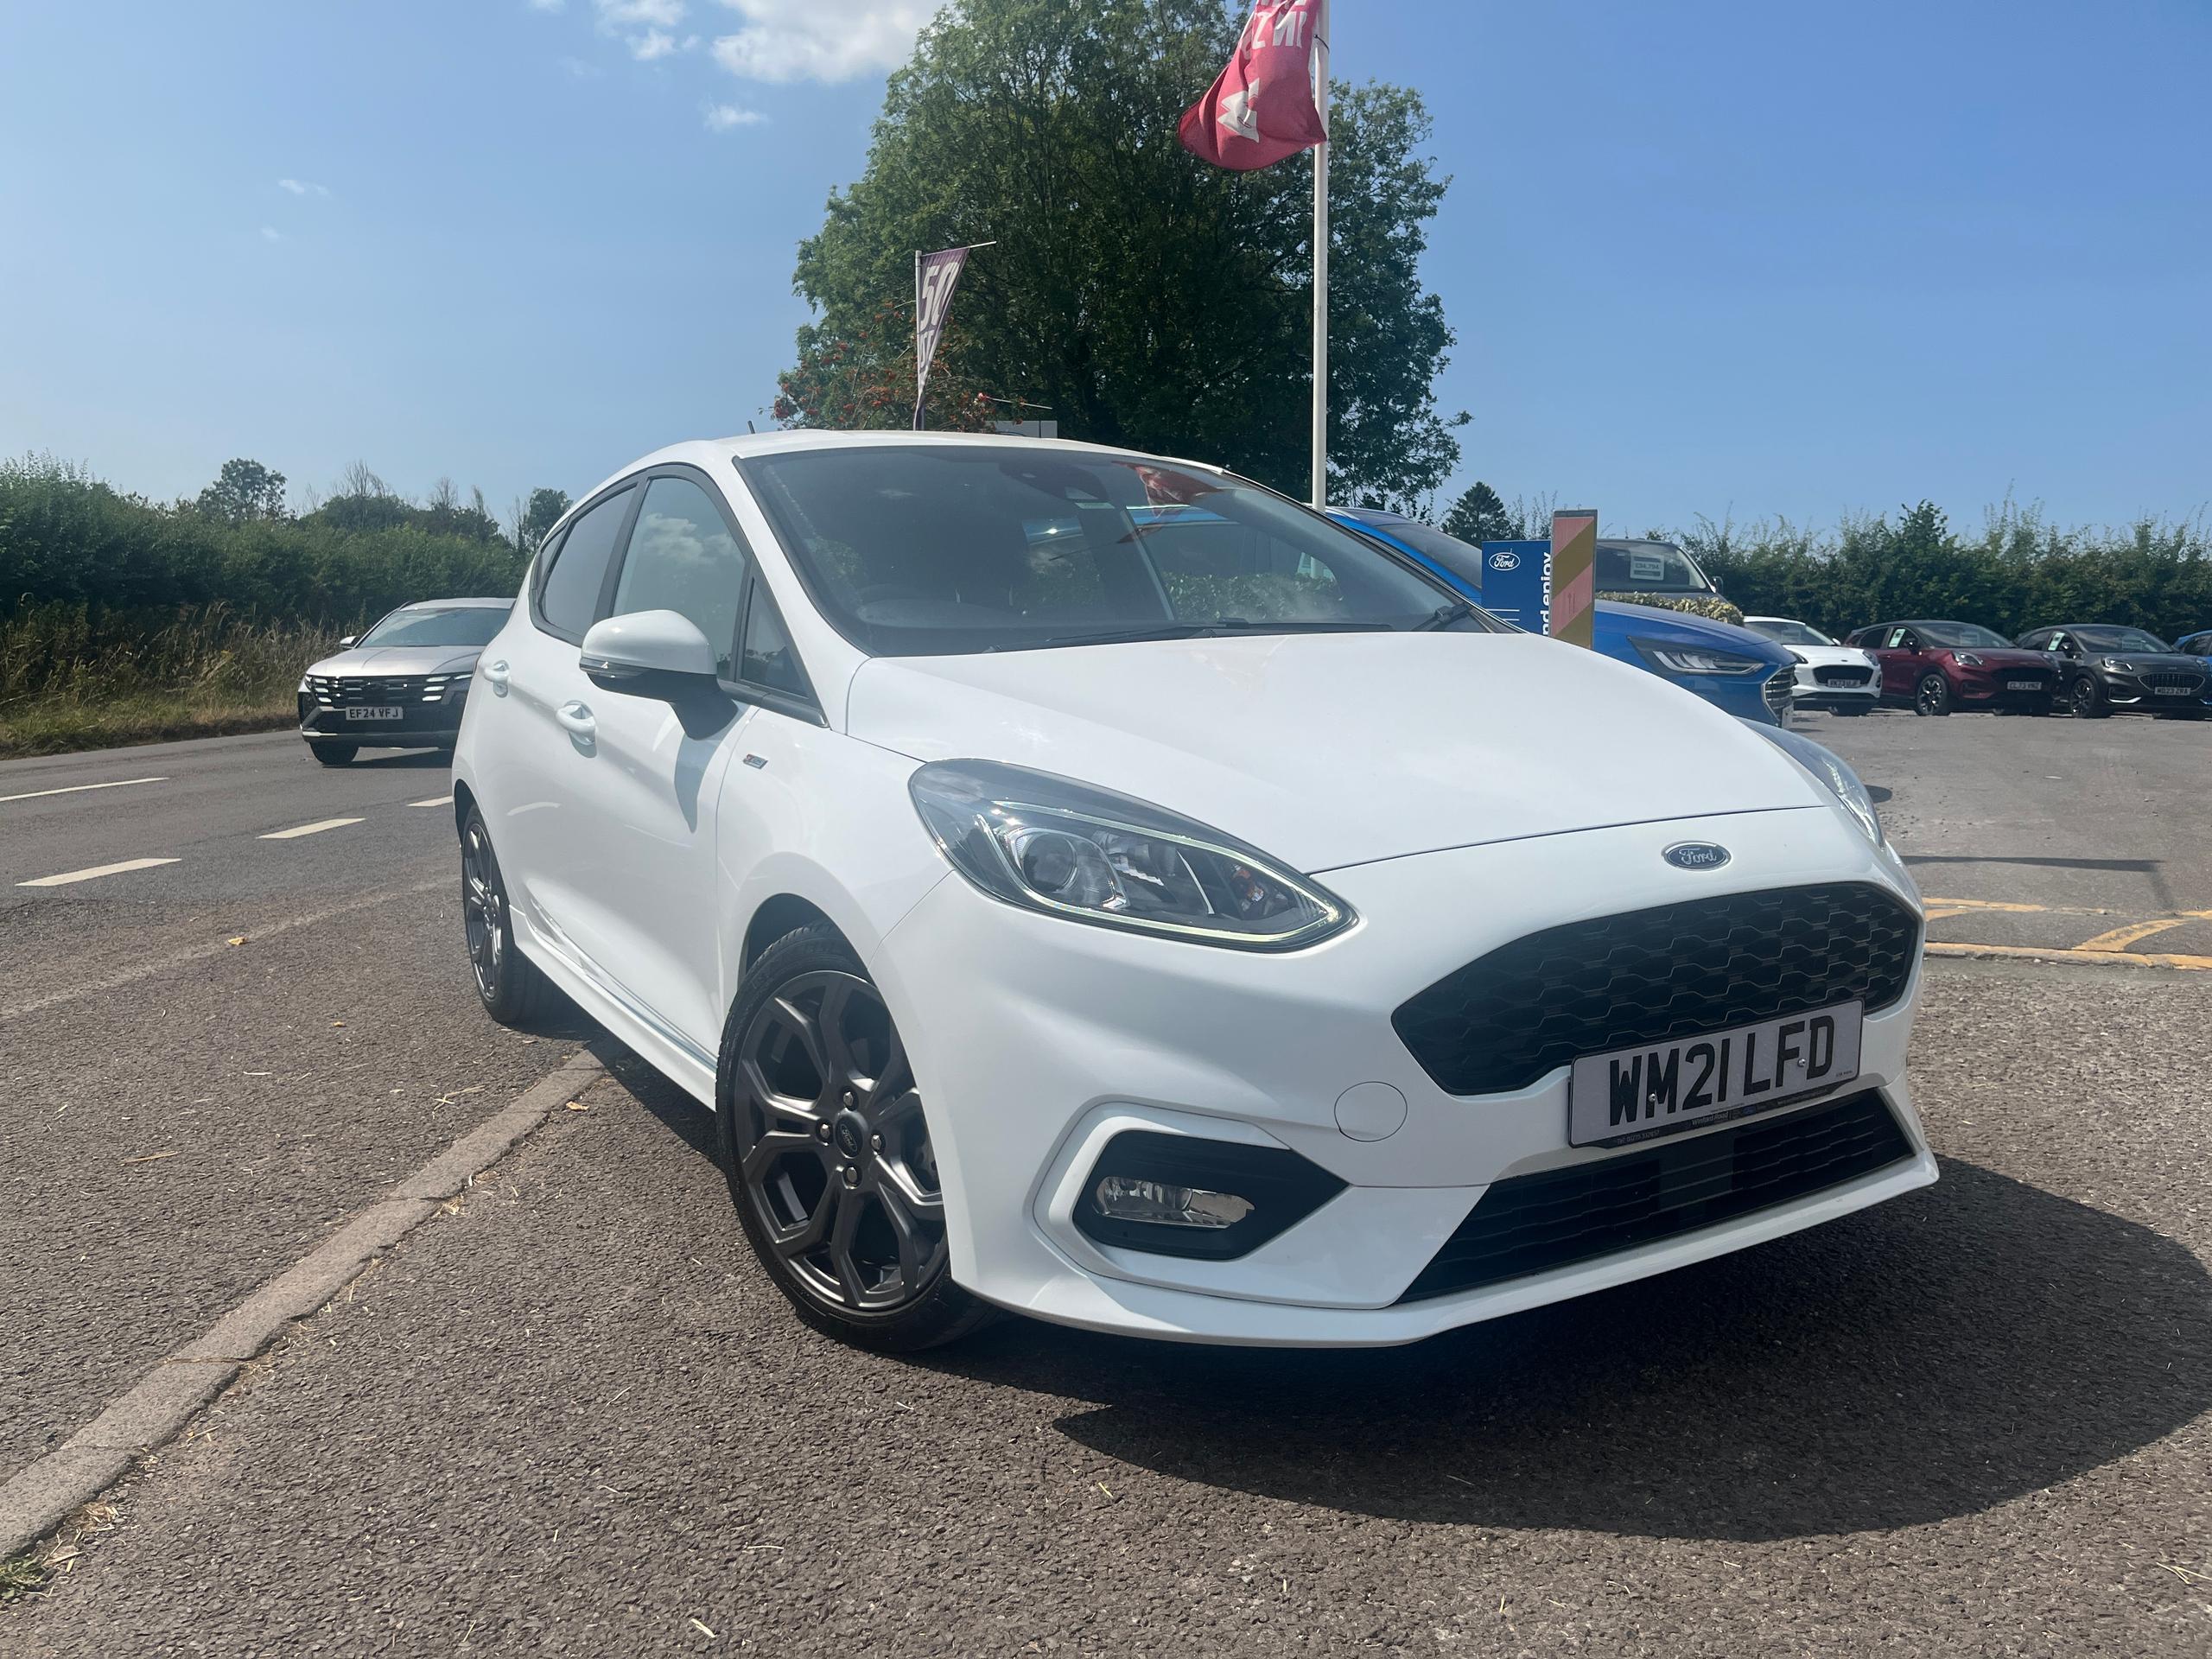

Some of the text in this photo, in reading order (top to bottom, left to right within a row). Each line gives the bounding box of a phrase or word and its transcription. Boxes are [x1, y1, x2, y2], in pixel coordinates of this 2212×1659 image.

[349, 708, 399, 719] EF24 VFJ
[1679, 848, 1717, 865] Ford
[1609, 1014, 1835, 1127] WM21 LFD
